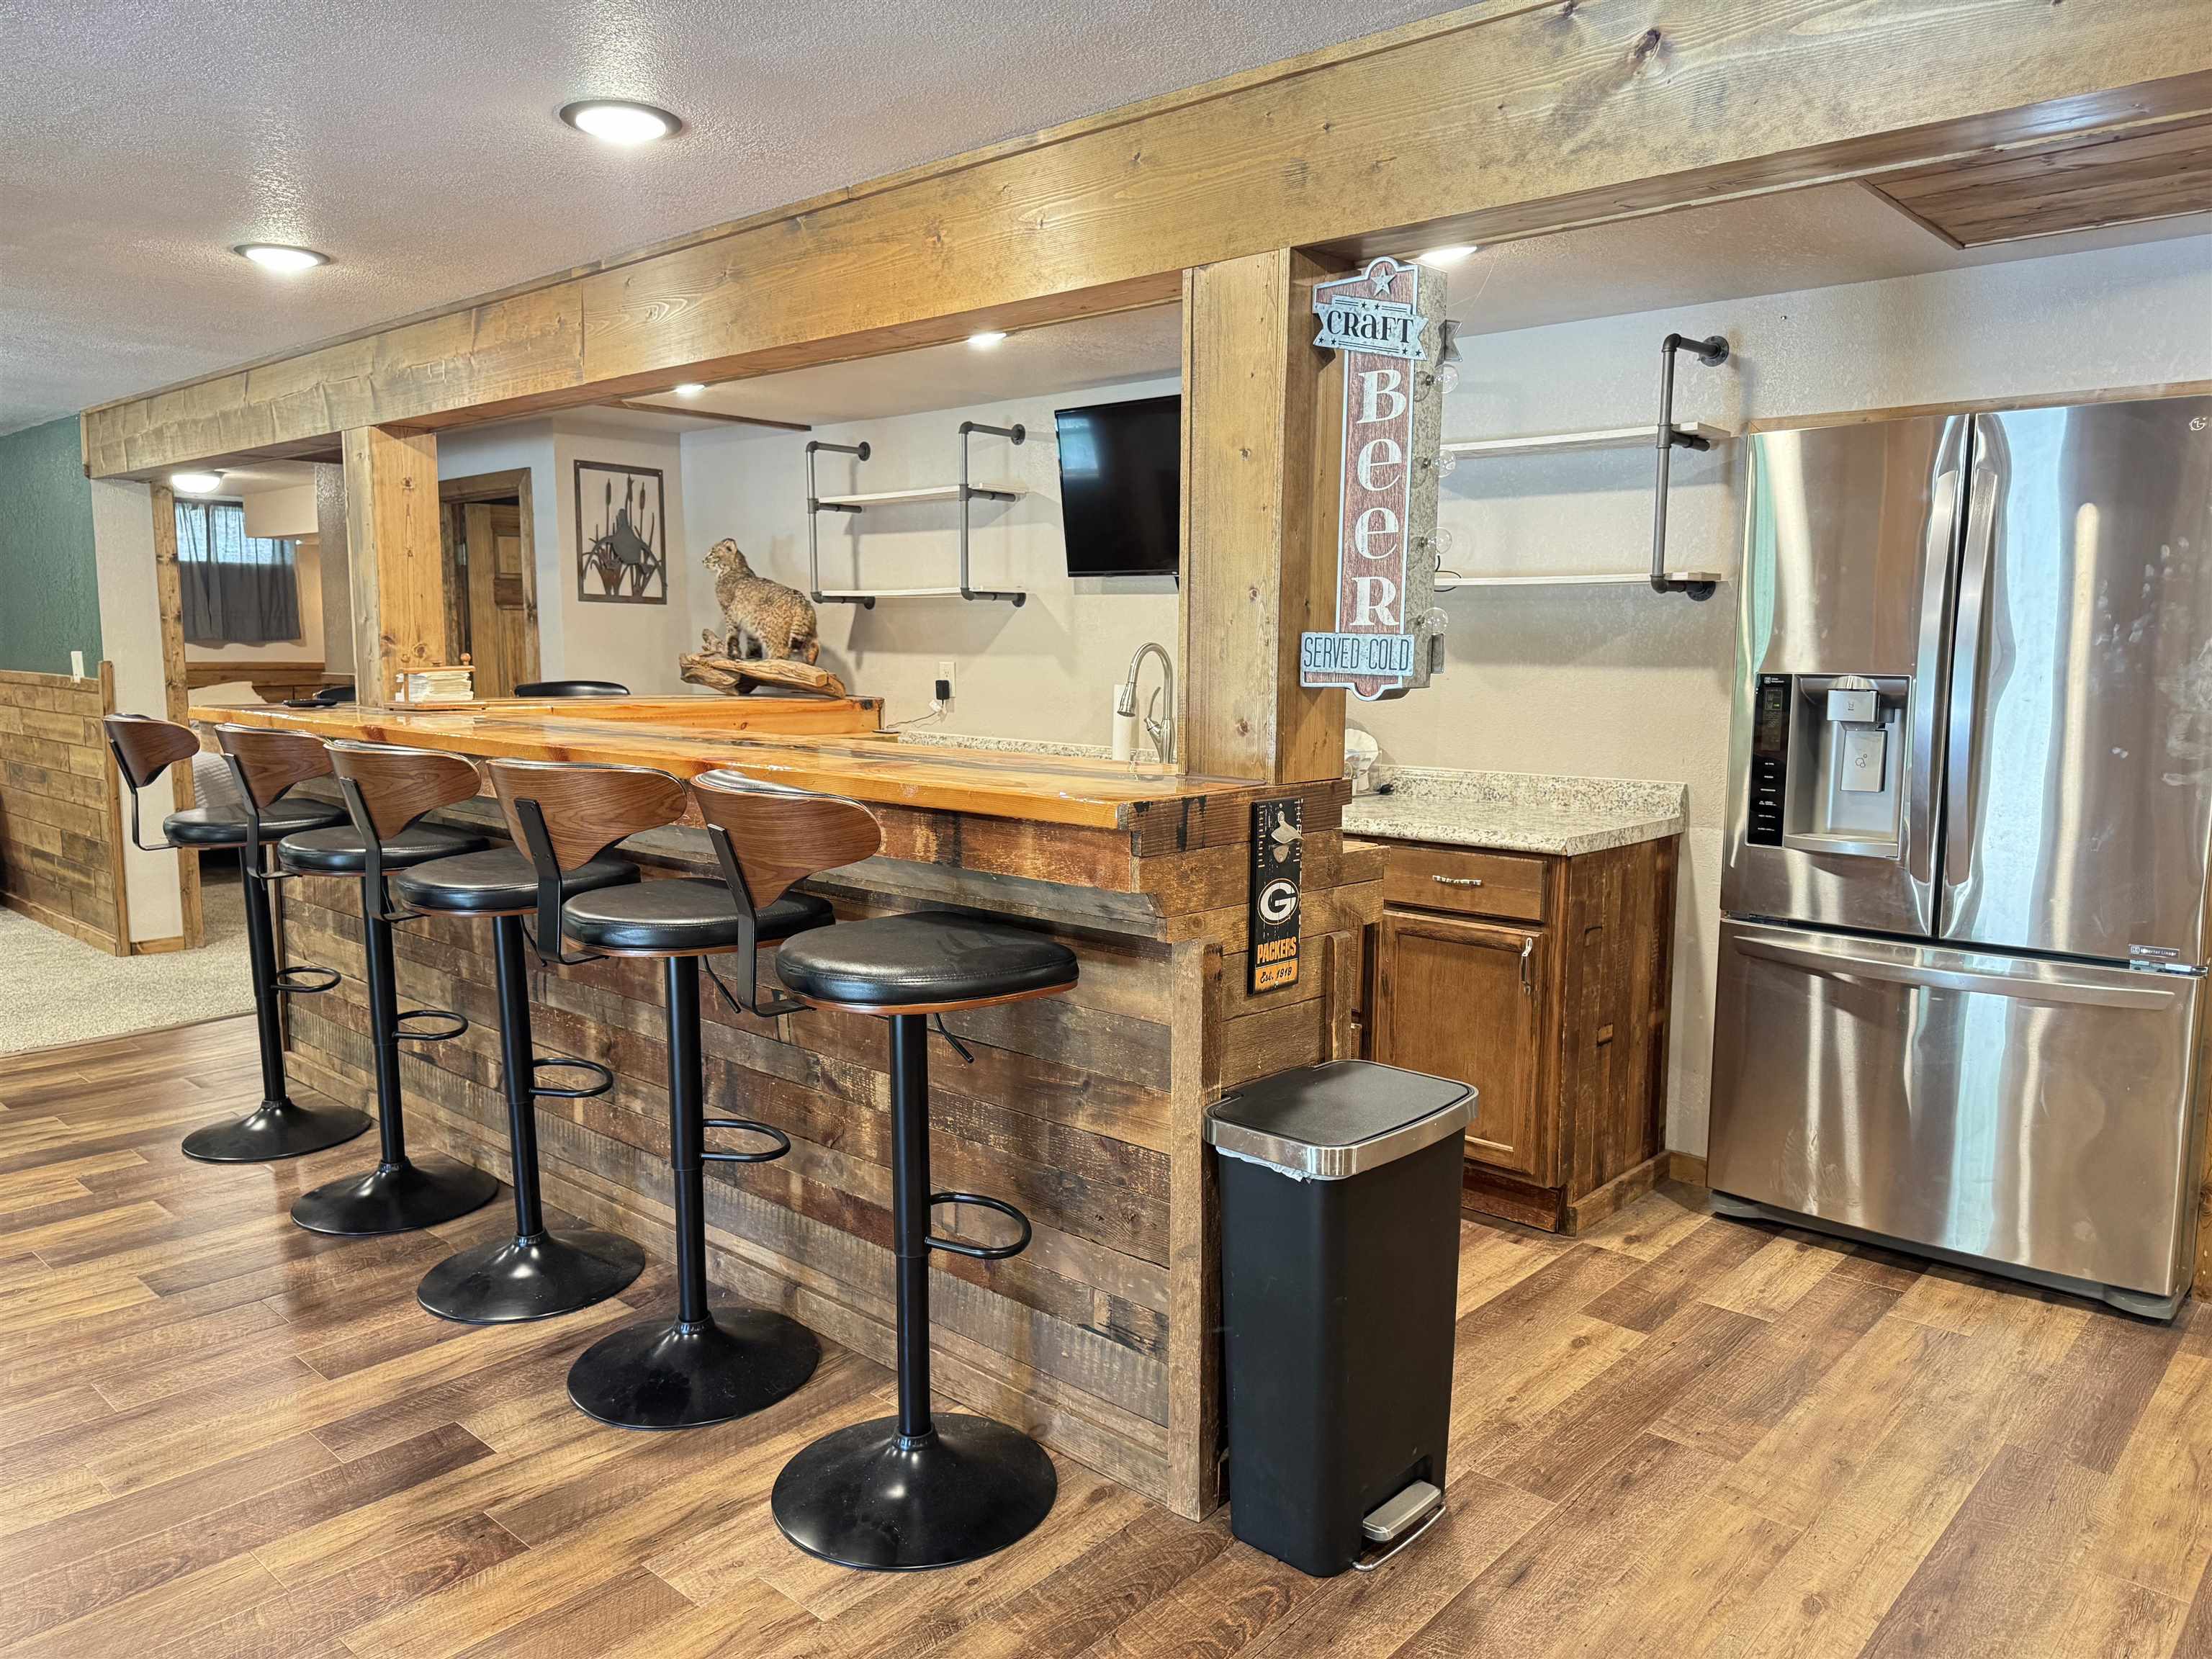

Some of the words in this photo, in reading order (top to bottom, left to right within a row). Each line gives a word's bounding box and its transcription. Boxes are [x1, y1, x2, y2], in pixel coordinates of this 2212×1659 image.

[1304, 637, 1360, 669] SERVED
[1369, 639, 1409, 671] COLD
[1260, 882, 1296, 921] G
[1257, 937, 1297, 964] PACKERS
